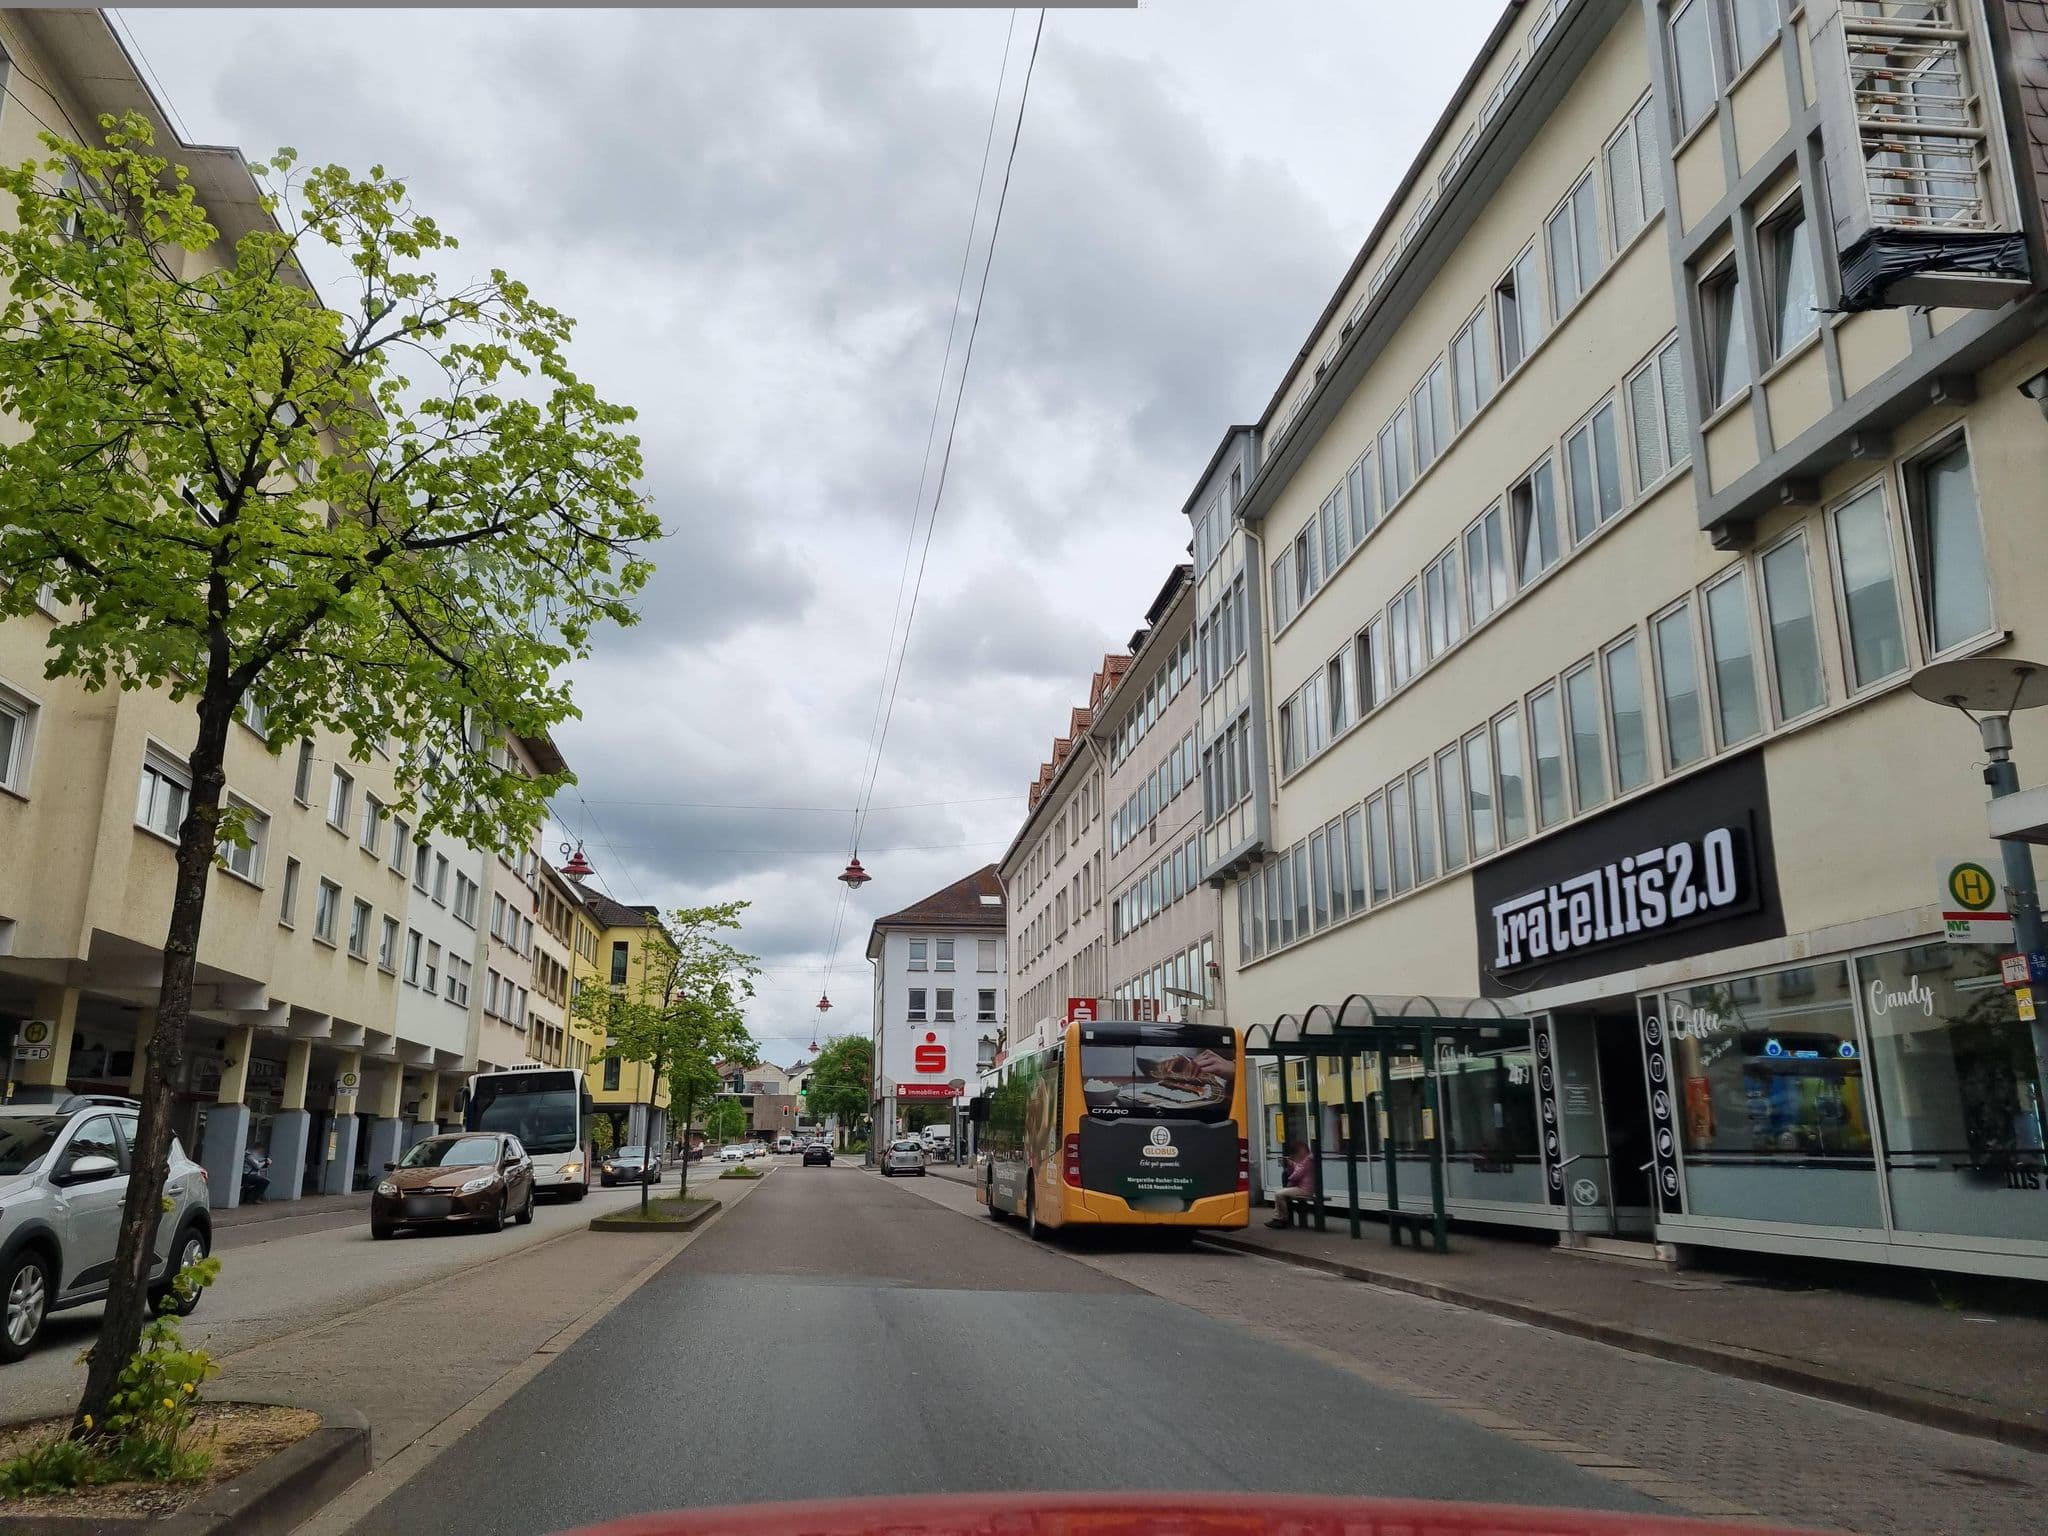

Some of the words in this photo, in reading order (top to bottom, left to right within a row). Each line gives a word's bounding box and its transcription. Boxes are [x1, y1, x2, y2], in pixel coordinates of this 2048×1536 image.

[1961, 873, 1983, 900] H
[1871, 975, 1936, 1016] Candy
[1673, 1005, 1722, 1040] Coffee
[1144, 1147, 1177, 1156] GLOBUS
